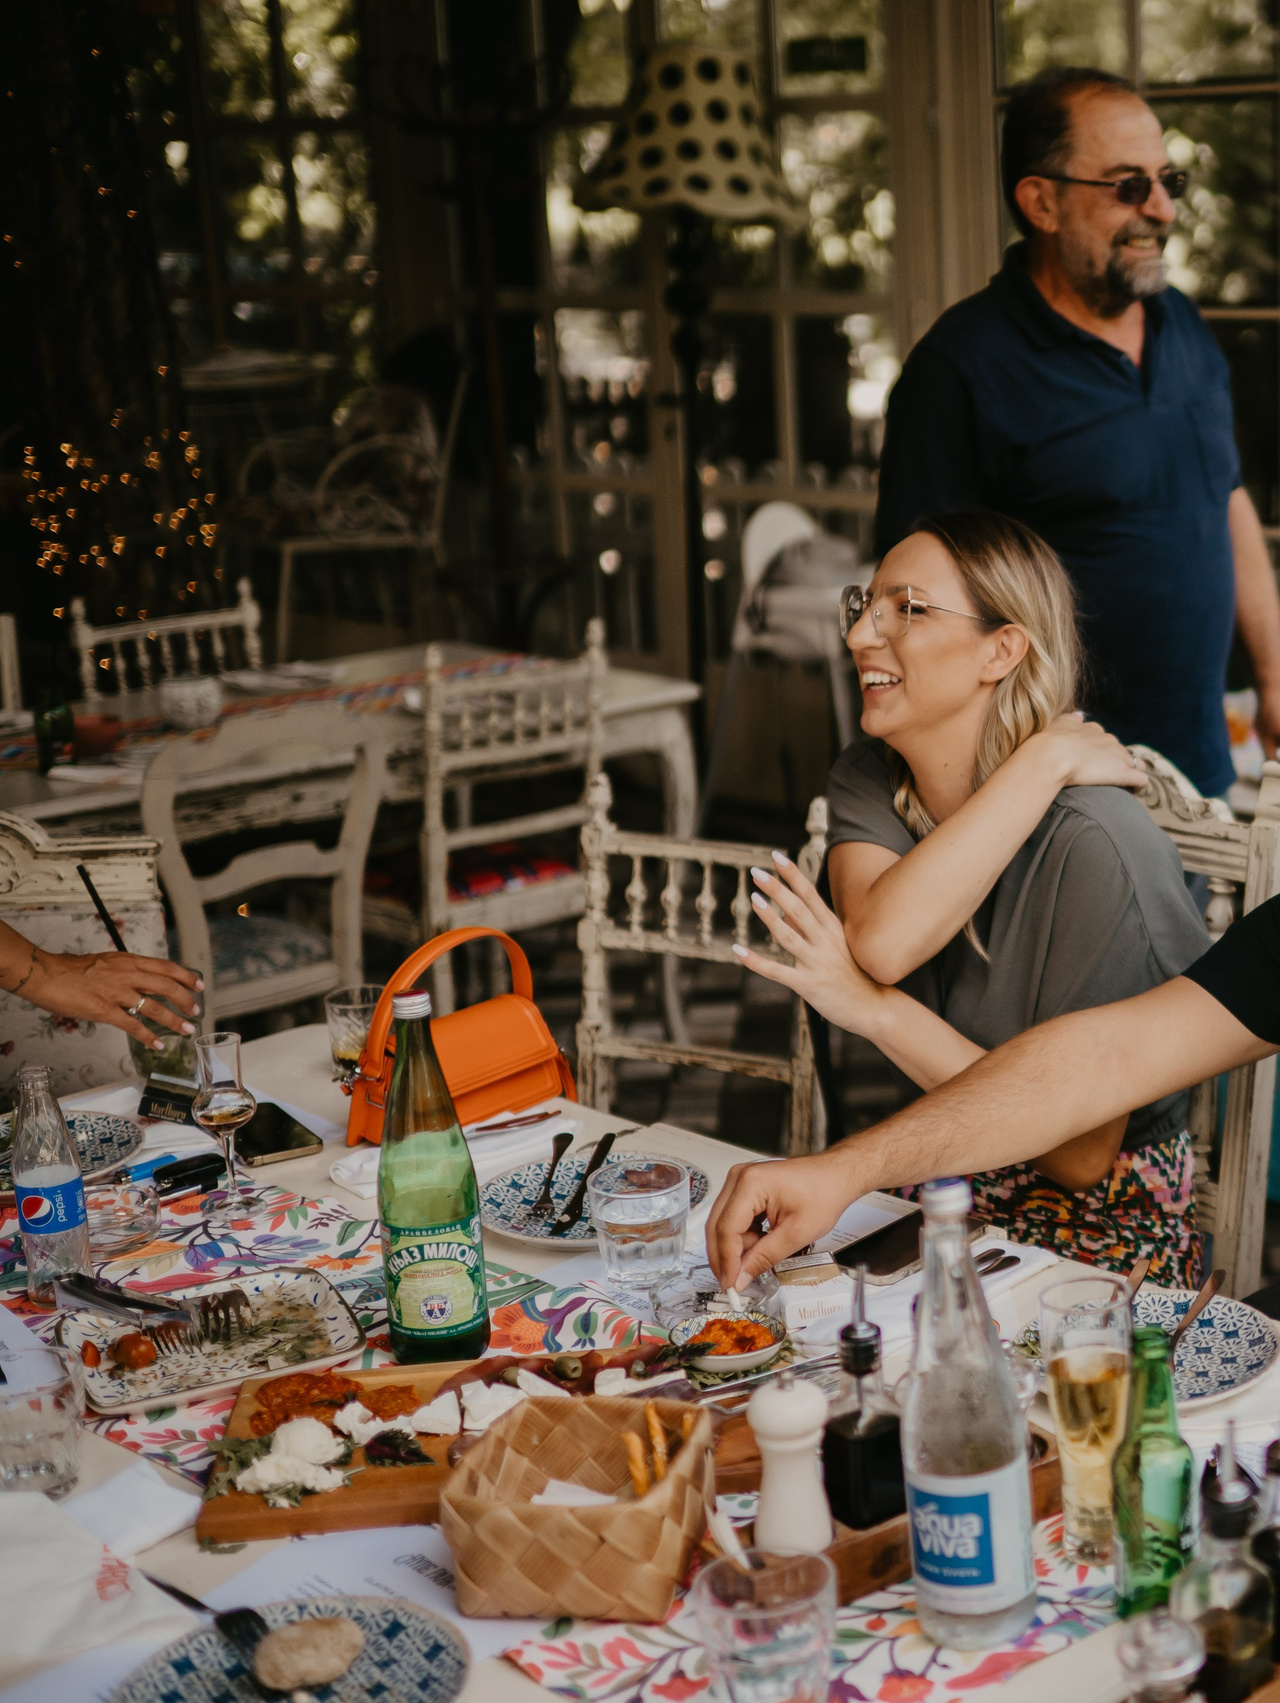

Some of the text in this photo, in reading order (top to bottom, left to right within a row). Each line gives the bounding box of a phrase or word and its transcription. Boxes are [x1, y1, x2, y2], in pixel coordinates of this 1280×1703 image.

[150, 1101, 187, 1120] Marlboro
[53, 1193, 68, 1223] pepsi
[387, 1243, 479, 1276] КЊАЗ МИЛОШ
[918, 1533, 980, 1560] viva
